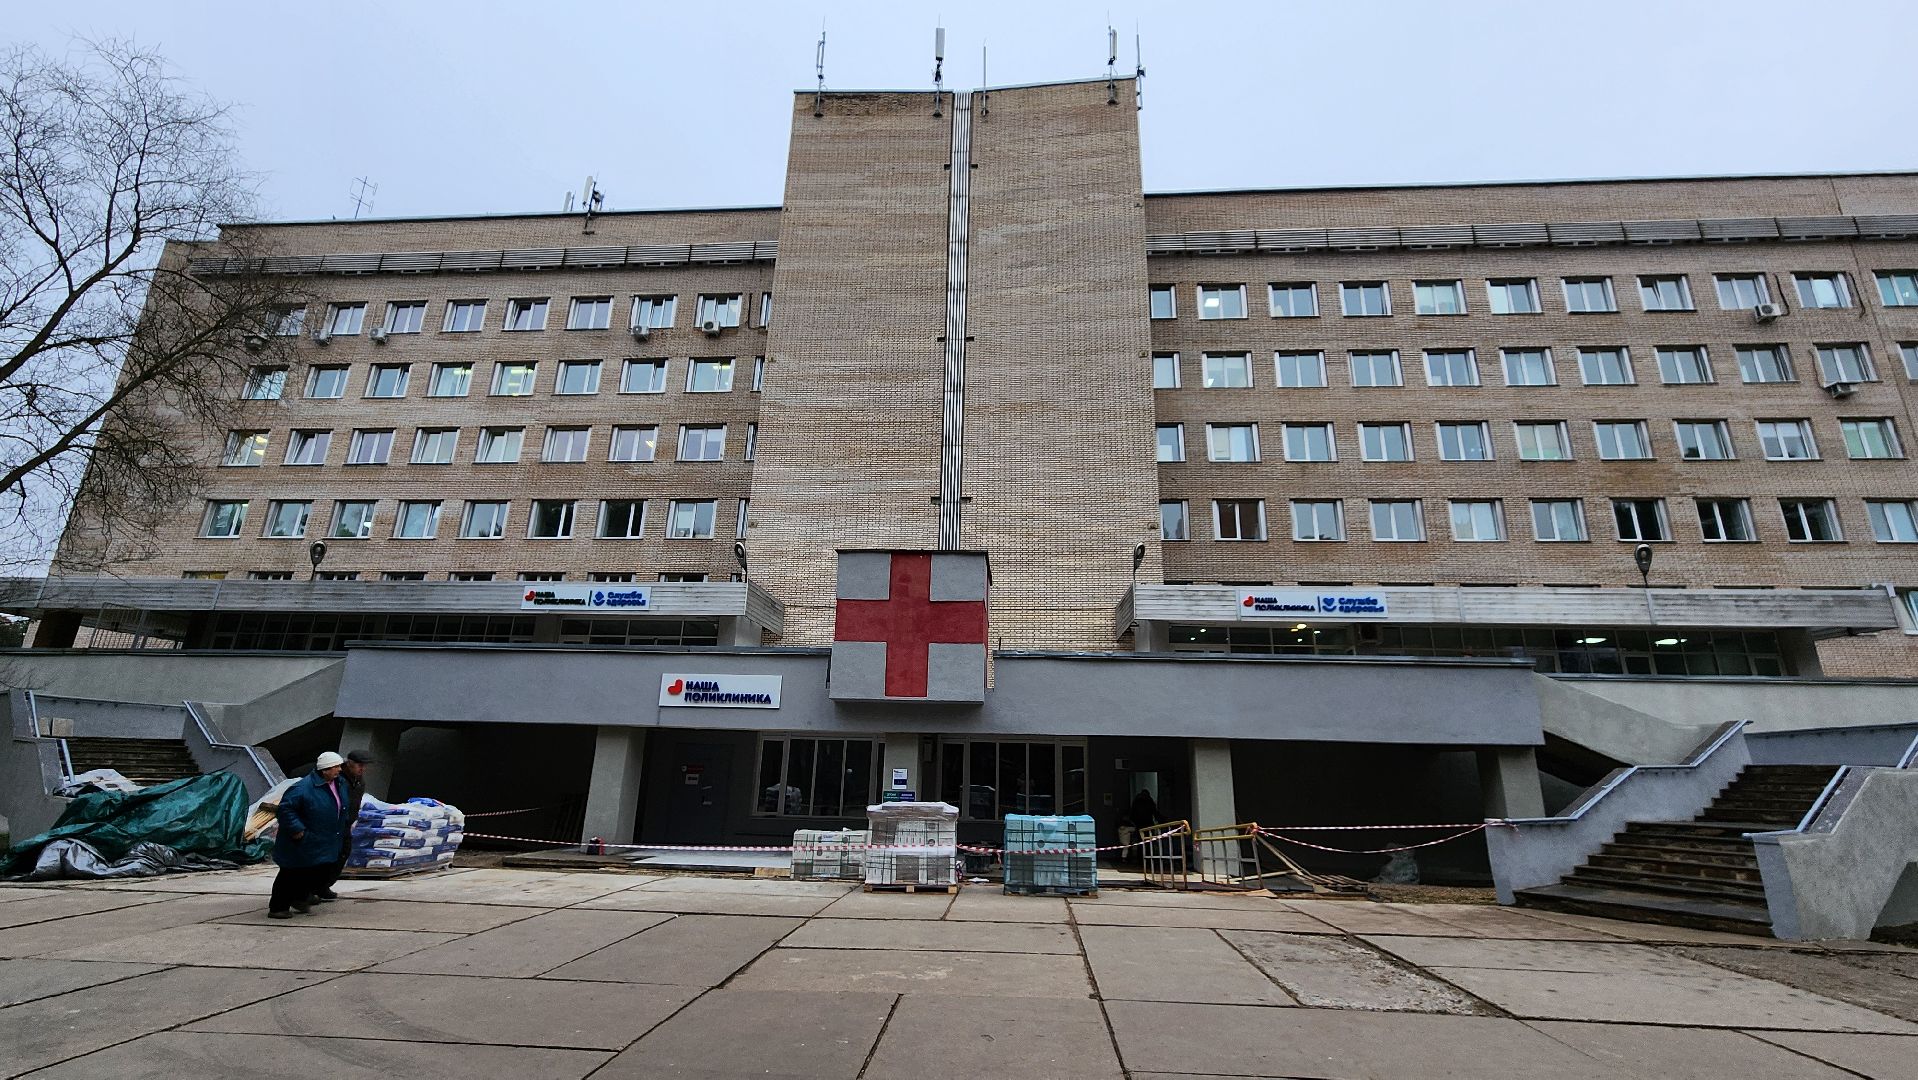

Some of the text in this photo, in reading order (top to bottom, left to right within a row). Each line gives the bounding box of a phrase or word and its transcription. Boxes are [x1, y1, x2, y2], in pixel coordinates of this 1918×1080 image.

[607, 591, 642, 600] Служба
[1338, 596, 1379, 606] Служба
[1338, 604, 1385, 613] здоровья
[685, 680, 720, 692] НАША
[684, 692, 772, 704] ПОЛИКЛИНИКА
